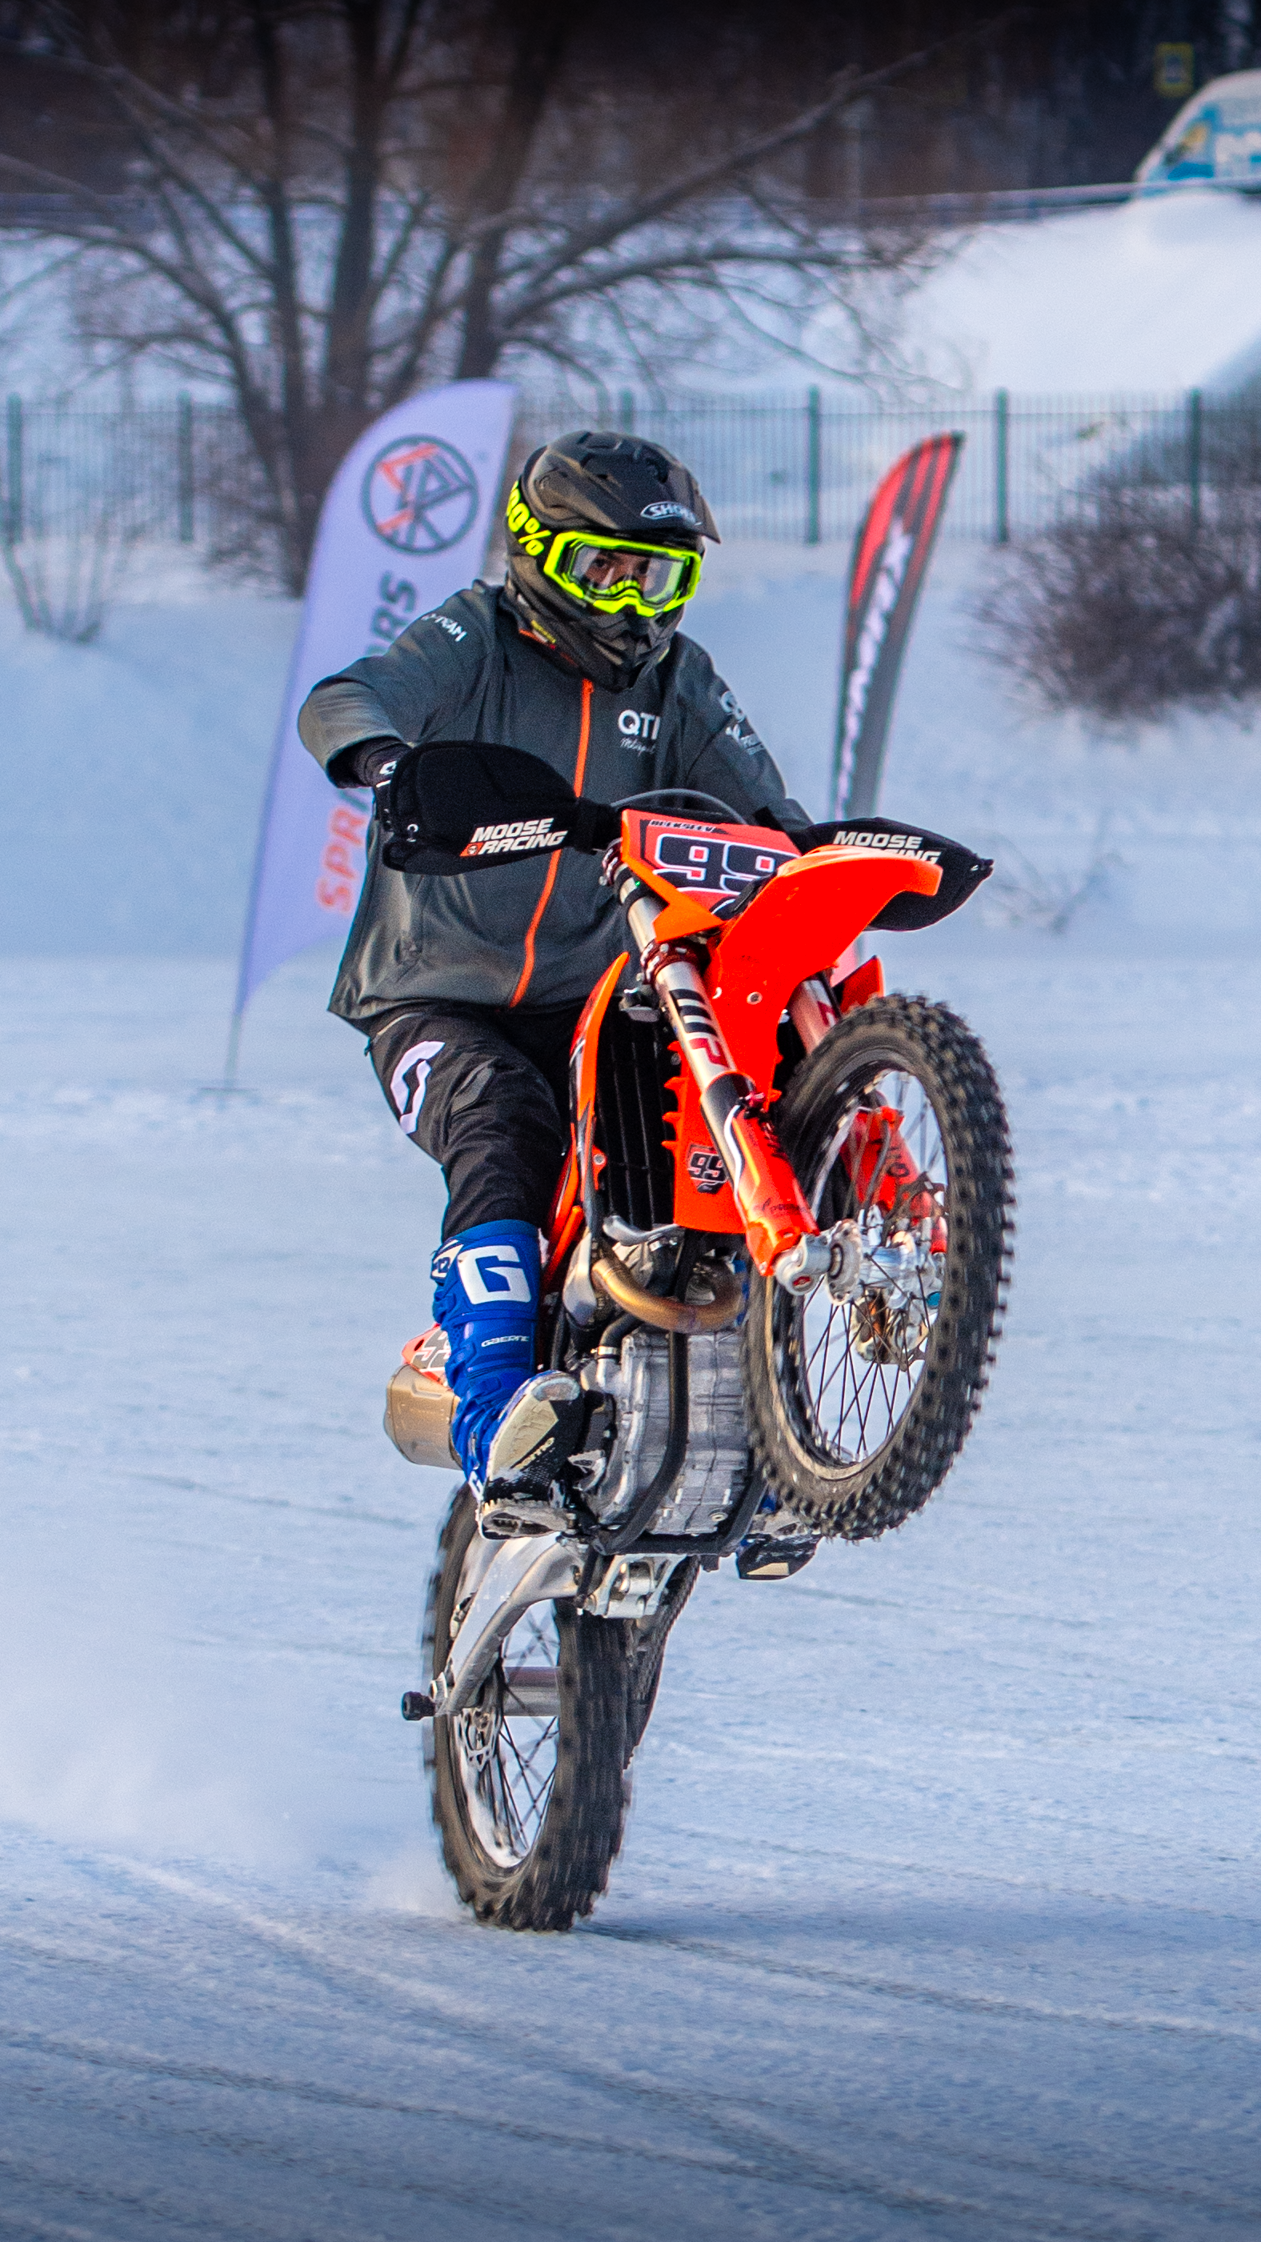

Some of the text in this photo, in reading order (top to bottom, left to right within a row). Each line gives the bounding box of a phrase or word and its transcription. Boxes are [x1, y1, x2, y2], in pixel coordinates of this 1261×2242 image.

[506, 480, 552, 556] 00%
[471, 817, 554, 843] MOOSE
[478, 830, 568, 855] RACING
[833, 830, 924, 849] MOOSE
[652, 833, 803, 896] 99
[457, 1245, 532, 1305] G
